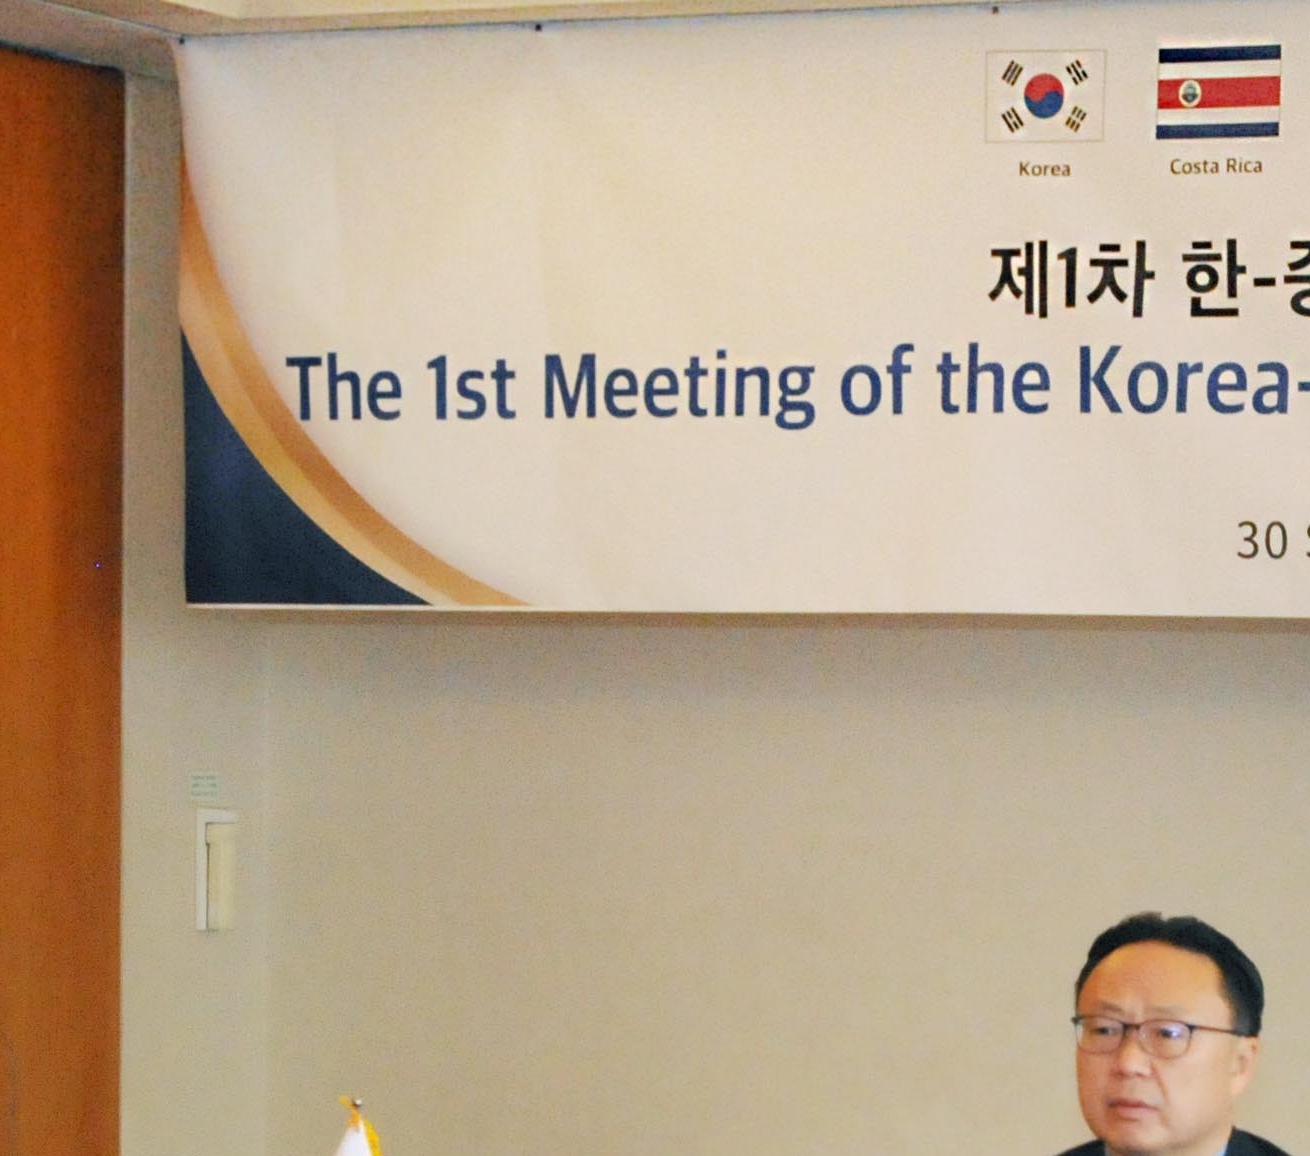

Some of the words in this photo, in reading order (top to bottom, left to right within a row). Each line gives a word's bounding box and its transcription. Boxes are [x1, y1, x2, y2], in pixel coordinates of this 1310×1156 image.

[1018, 161, 1071, 177] Korea
[1169, 158, 1220, 176] Costa
[1226, 157, 1263, 174] Rica
[987, 239, 1156, 319] 제1차
[288, 354, 403, 421] The
[426, 354, 517, 421] 1st
[544, 349, 816, 431] Meeting
[839, 344, 915, 417] of
[935, 344, 1051, 415] the
[1236, 520, 1288, 560] 30
